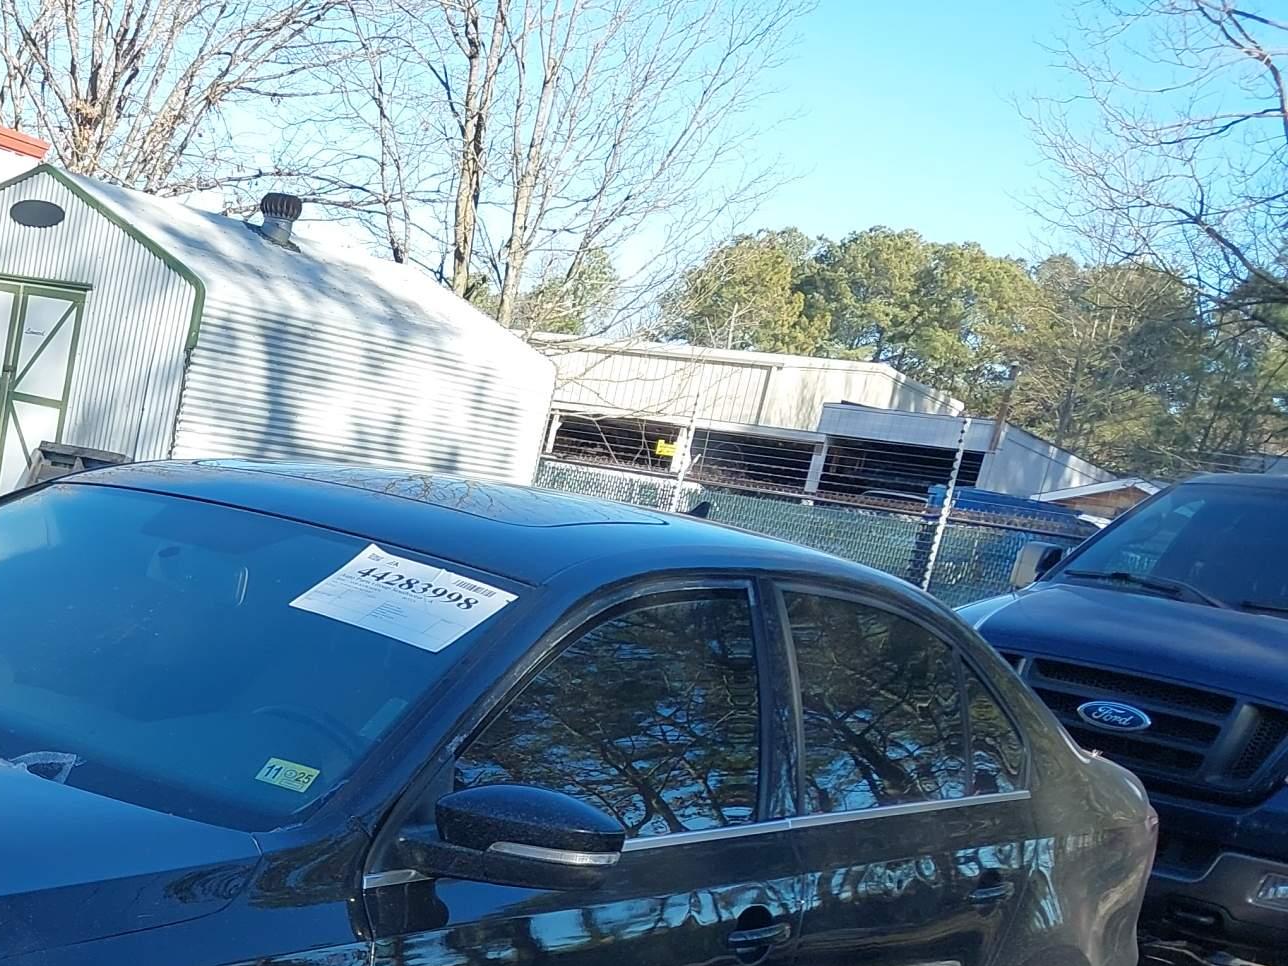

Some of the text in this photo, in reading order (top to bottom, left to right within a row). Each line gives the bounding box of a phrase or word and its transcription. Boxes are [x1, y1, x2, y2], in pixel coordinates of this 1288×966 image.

[358, 568, 479, 610] 44283998
[1092, 706, 1133, 725] Ford
[264, 765, 314, 784] 11 25
